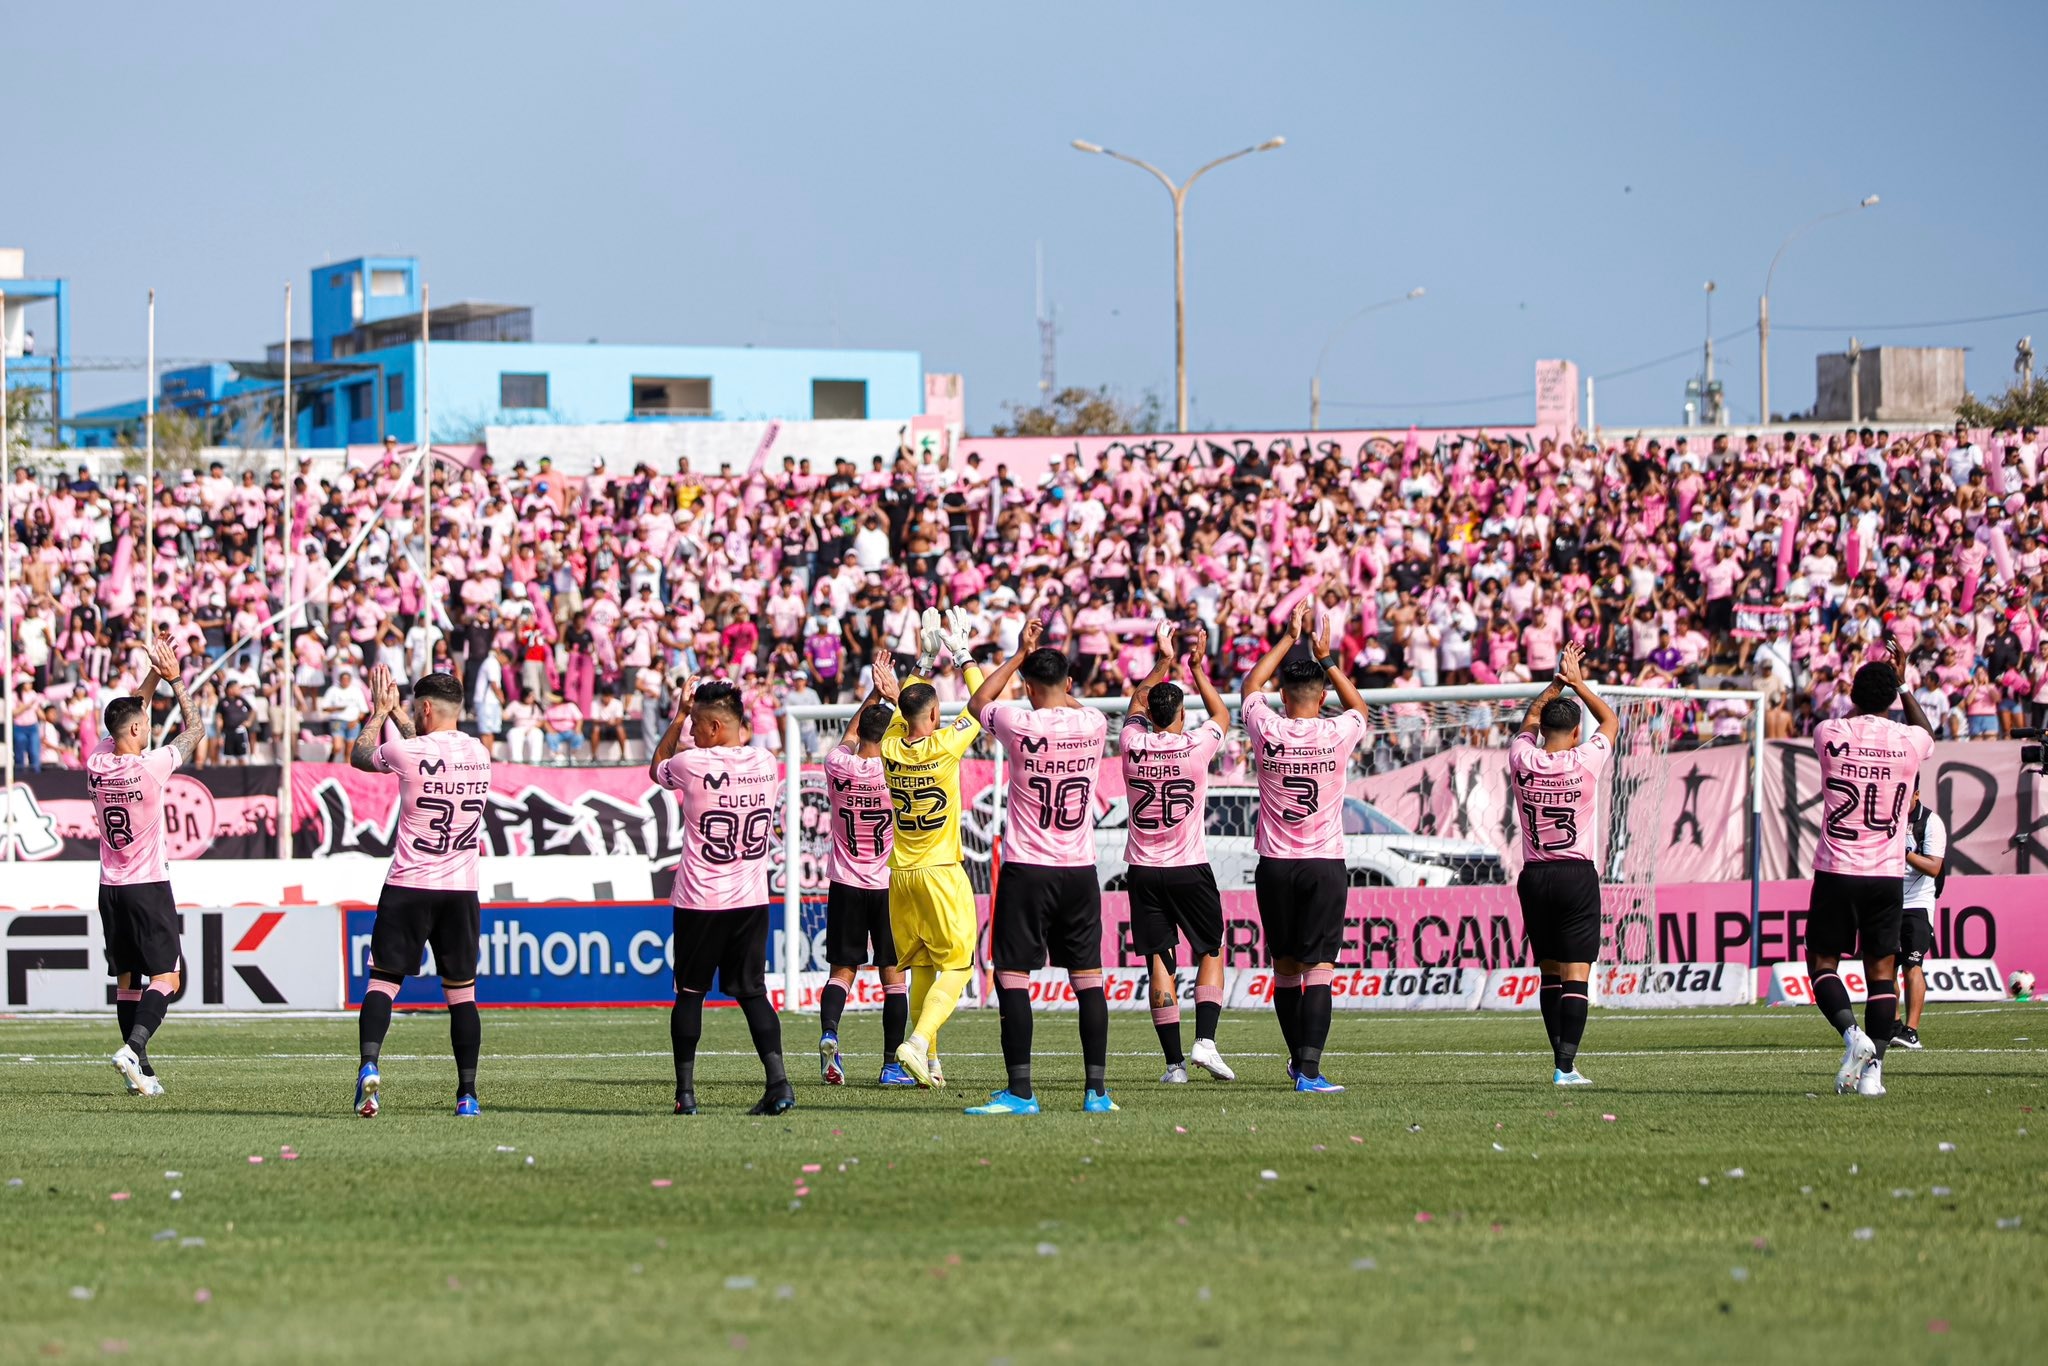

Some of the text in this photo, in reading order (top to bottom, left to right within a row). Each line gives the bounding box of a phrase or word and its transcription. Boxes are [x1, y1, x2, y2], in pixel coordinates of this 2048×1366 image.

[1056, 738, 1100, 750] Movistar
[1292, 746, 1336, 756] Movistar
[1153, 751, 1191, 760] Movistar
[1858, 748, 1907, 758] Movistar
[454, 763, 490, 772] Movista
[905, 761, 939, 772] Movistar
[1024, 757, 1095, 774] ALARCON
[1137, 765, 1180, 779] RIOJAS
[1263, 760, 1336, 775] ZAMBRANO
[1841, 763, 1891, 780] MORA
[107, 775, 142, 787] Movistar
[737, 773, 776, 785] Movistar
[858, 782, 890, 792] Movist
[890, 776, 936, 789] MELIAN
[1541, 776, 1584, 787] Movistar
[104, 790, 144, 804] CAMPO
[718, 793, 766, 809] CUEVA
[846, 797, 882, 808] SABA
[1028, 776, 1091, 831] 10
[1128, 778, 1196, 830] 26
[1282, 776, 1319, 821] 3
[1521, 789, 1582, 805] LLONTOP
[890, 786, 948, 831] 22
[1825, 776, 1907, 841] 24
[103, 806, 134, 850] 8
[412, 796, 485, 855] 32
[839, 808, 893, 858] 17
[1521, 803, 1578, 851] 13
[699, 808, 772, 865] 99
[1412, 898, 1697, 969] CAMÓN
[1714, 905, 1997, 967] PENO
[6, 911, 288, 1005] FK
[1249, 966, 1463, 1004] apstatotal
[1497, 961, 1725, 1005] aptatotal
